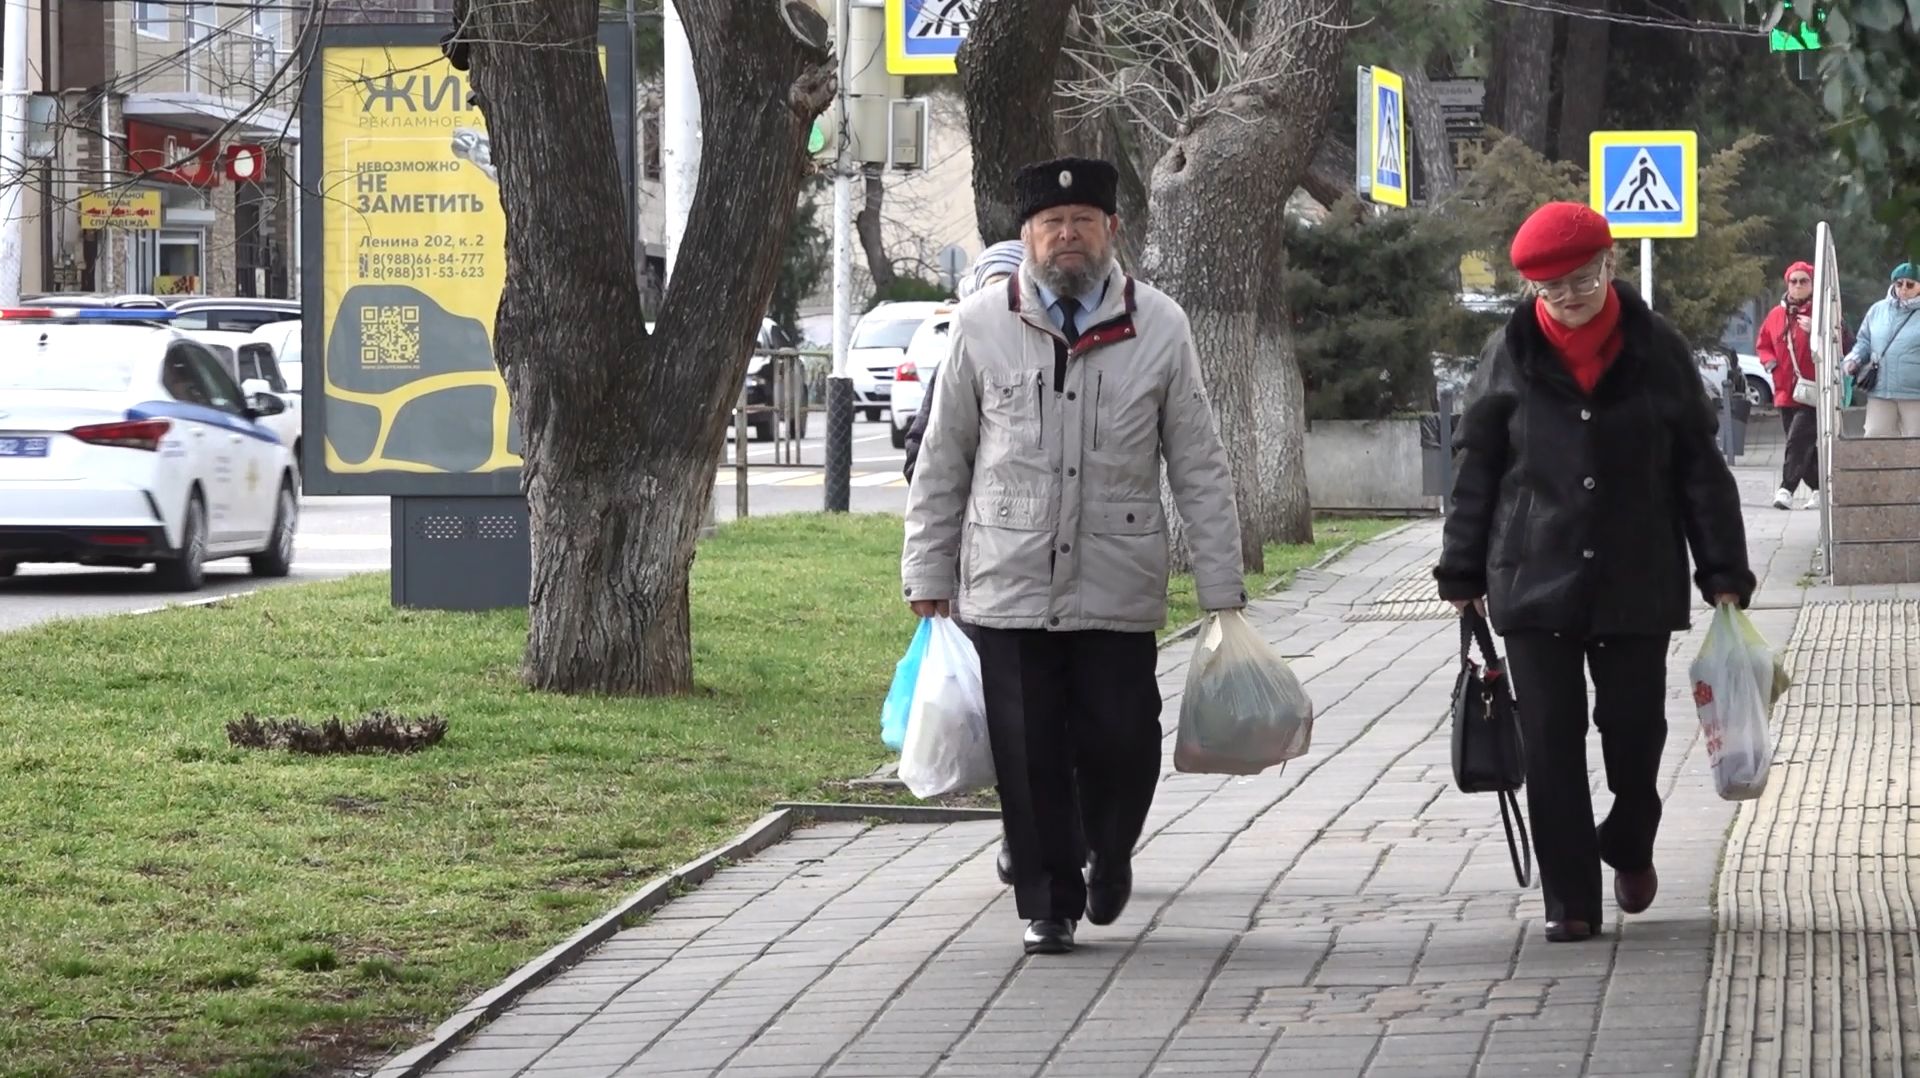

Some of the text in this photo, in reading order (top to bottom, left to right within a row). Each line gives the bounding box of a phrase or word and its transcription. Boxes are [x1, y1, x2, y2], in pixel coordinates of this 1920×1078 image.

[358, 116, 462, 128] РЕКЛАМНОЕ
[357, 161, 460, 172] НЕВОЗМОЖНО
[357, 174, 388, 192] НЕ
[357, 194, 484, 213] ЗАМЕТИТЬ
[360, 236, 419, 248] Ленина
[424, 235, 455, 249] 202,
[372, 252, 484, 267] 8(988)66-84-777
[372, 266, 484, 281] 8(988)31-53-623
